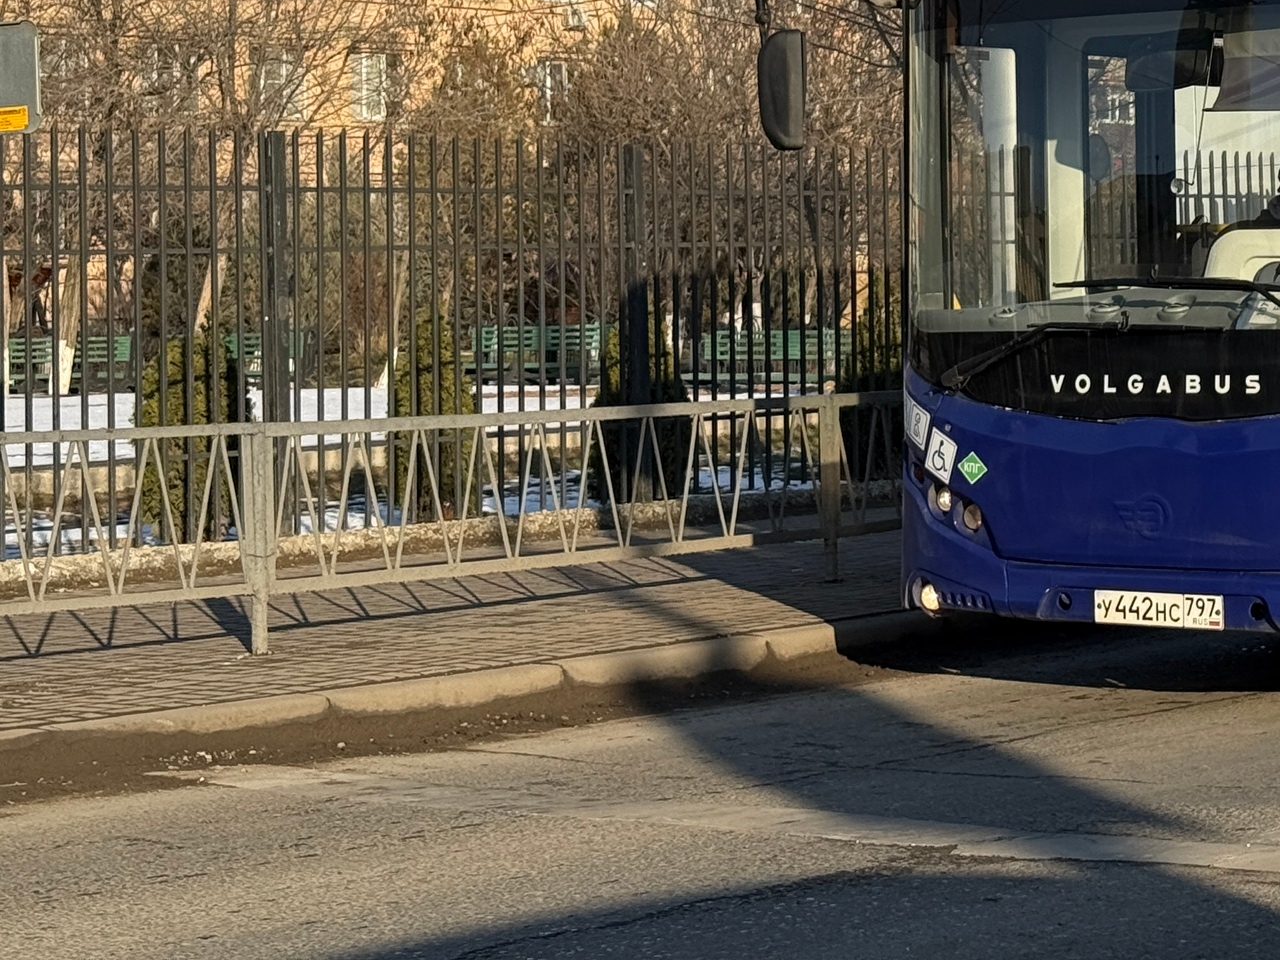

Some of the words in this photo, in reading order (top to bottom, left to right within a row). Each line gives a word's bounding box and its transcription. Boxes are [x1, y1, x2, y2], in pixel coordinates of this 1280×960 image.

[1049, 373, 1263, 396] VOLGABUS
[963, 461, 981, 474] КПГ
[1185, 597, 1216, 618] 797
[1192, 617, 1209, 626] RUS
